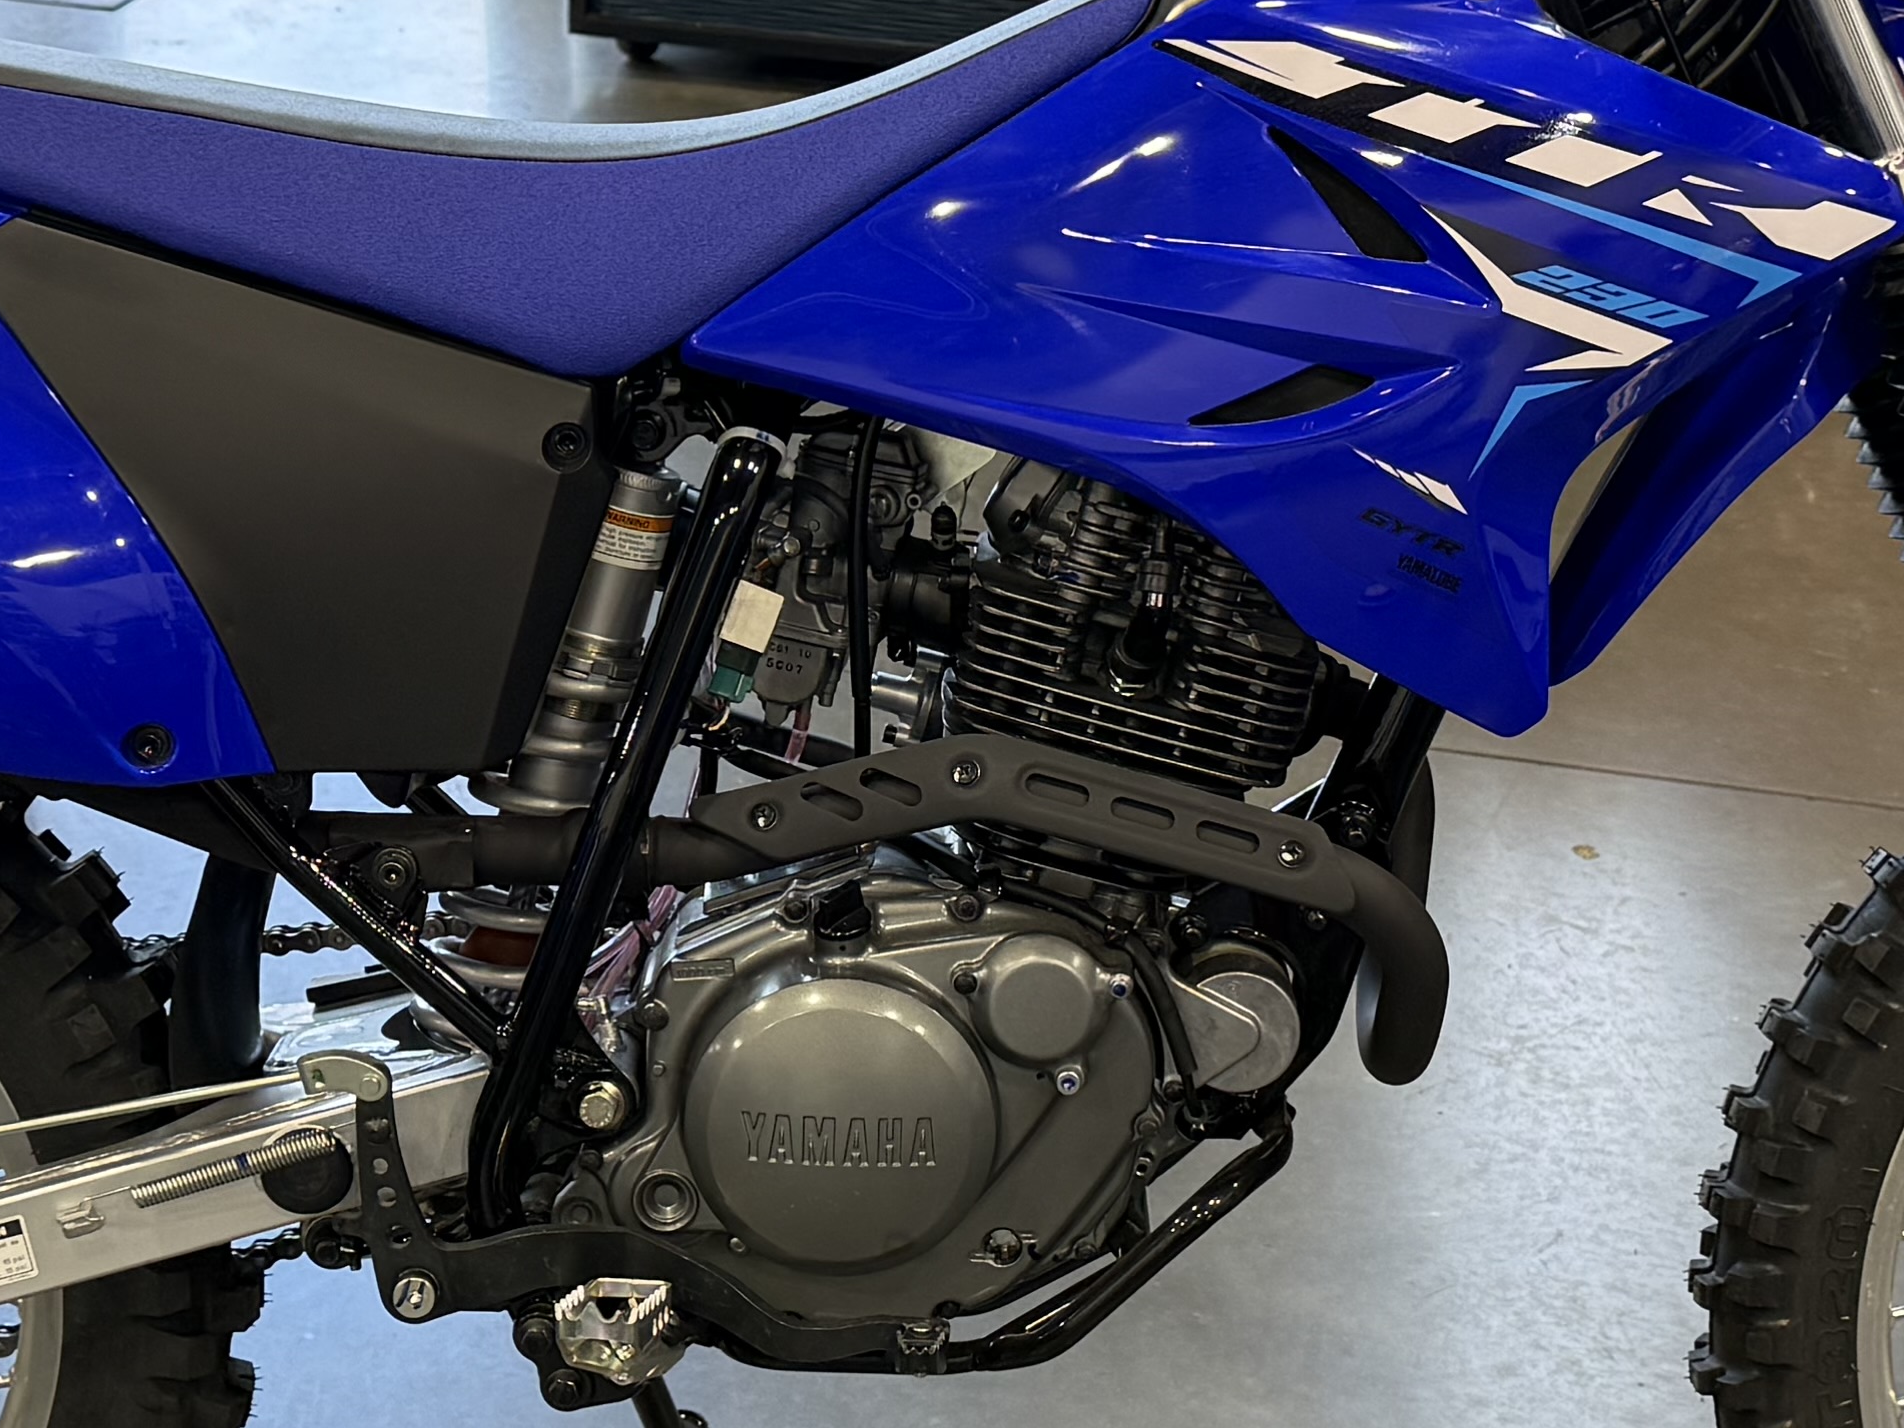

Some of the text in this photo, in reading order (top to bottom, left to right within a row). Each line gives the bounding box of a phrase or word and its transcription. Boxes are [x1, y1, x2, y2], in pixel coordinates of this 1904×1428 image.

[1509, 263, 1711, 329] 230
[1360, 507, 1465, 559] GYTR
[740, 1109, 938, 1168] YAMAHA
